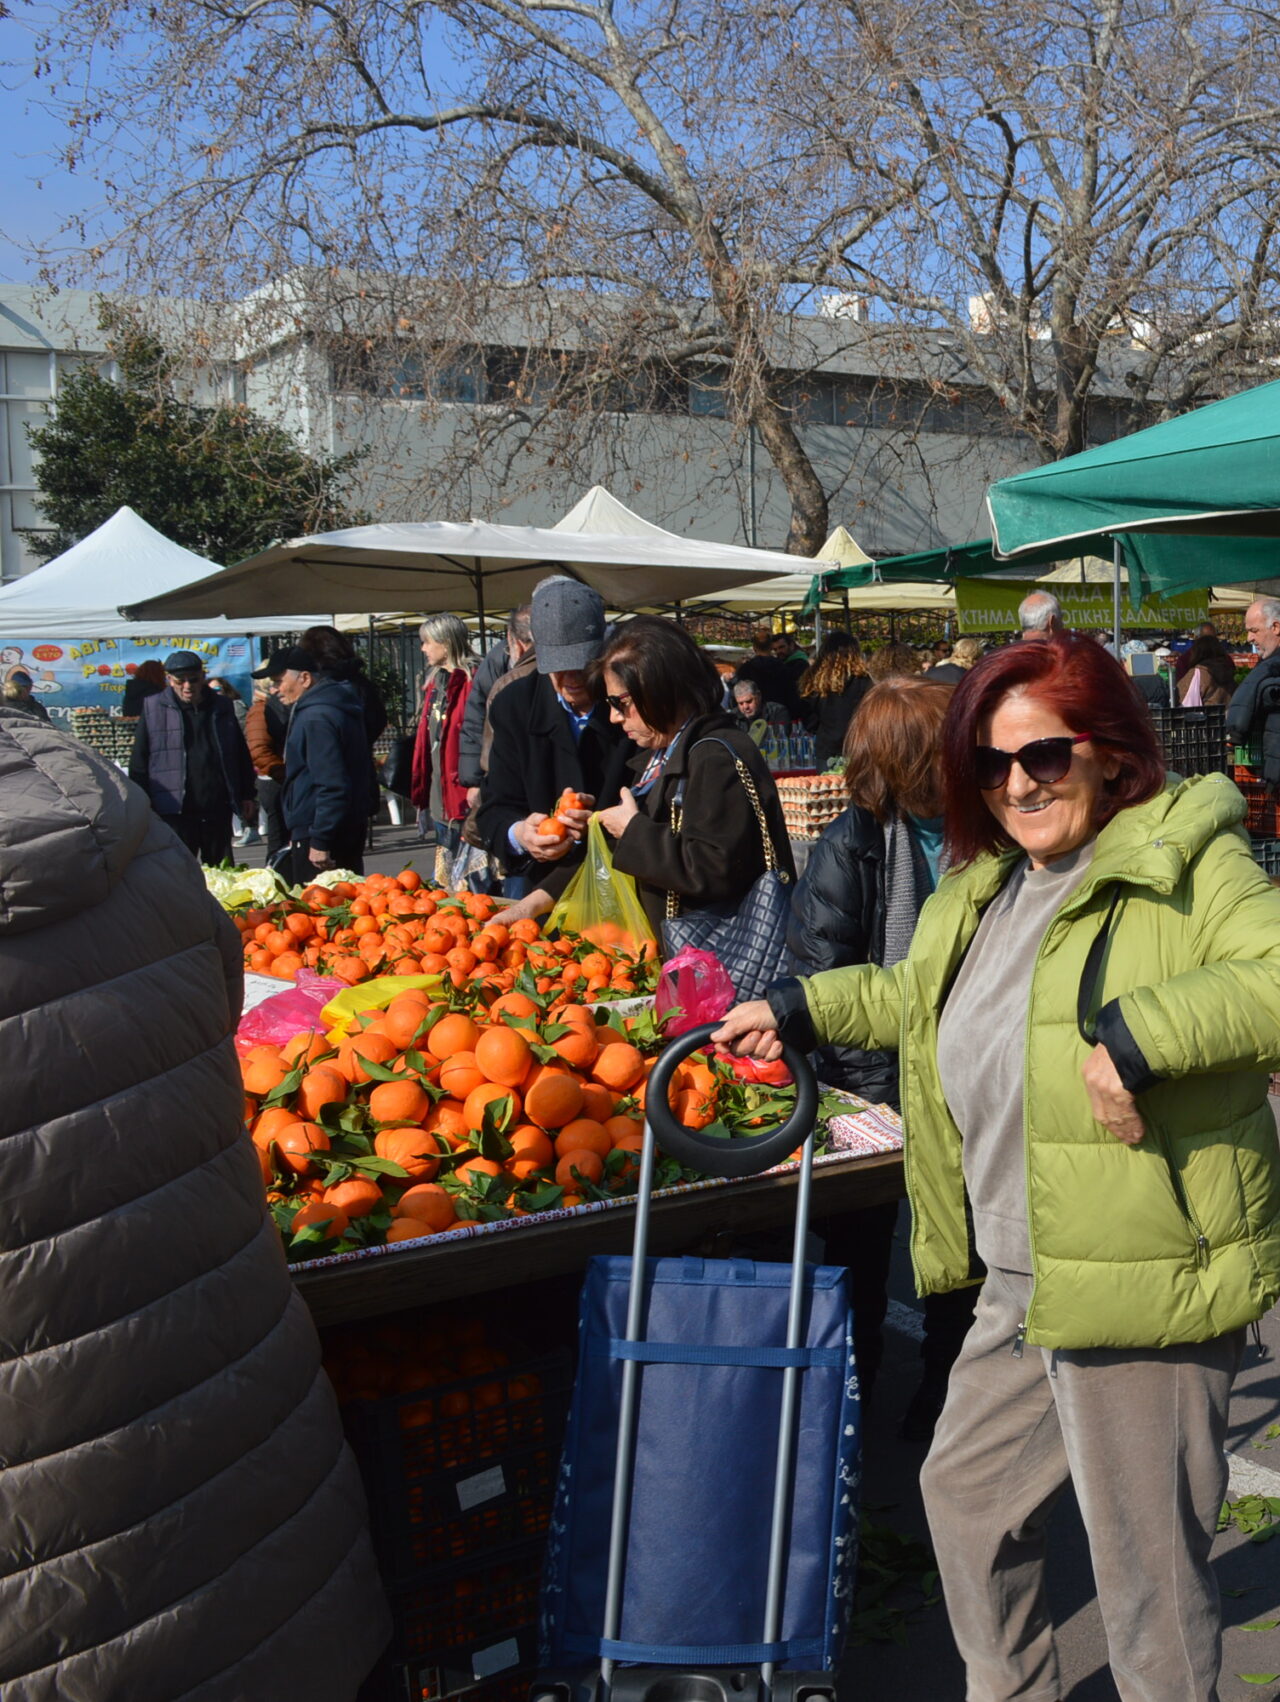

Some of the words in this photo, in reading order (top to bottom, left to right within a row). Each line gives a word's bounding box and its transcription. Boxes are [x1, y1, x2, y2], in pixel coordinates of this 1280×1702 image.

[961, 609, 1016, 624] ΚΤΗΜΑ
[1061, 608, 1113, 624] ΟΓΙΚΗΣ
[1119, 607, 1211, 623] ΑΛΛΙΕΡΓΕΙΑ
